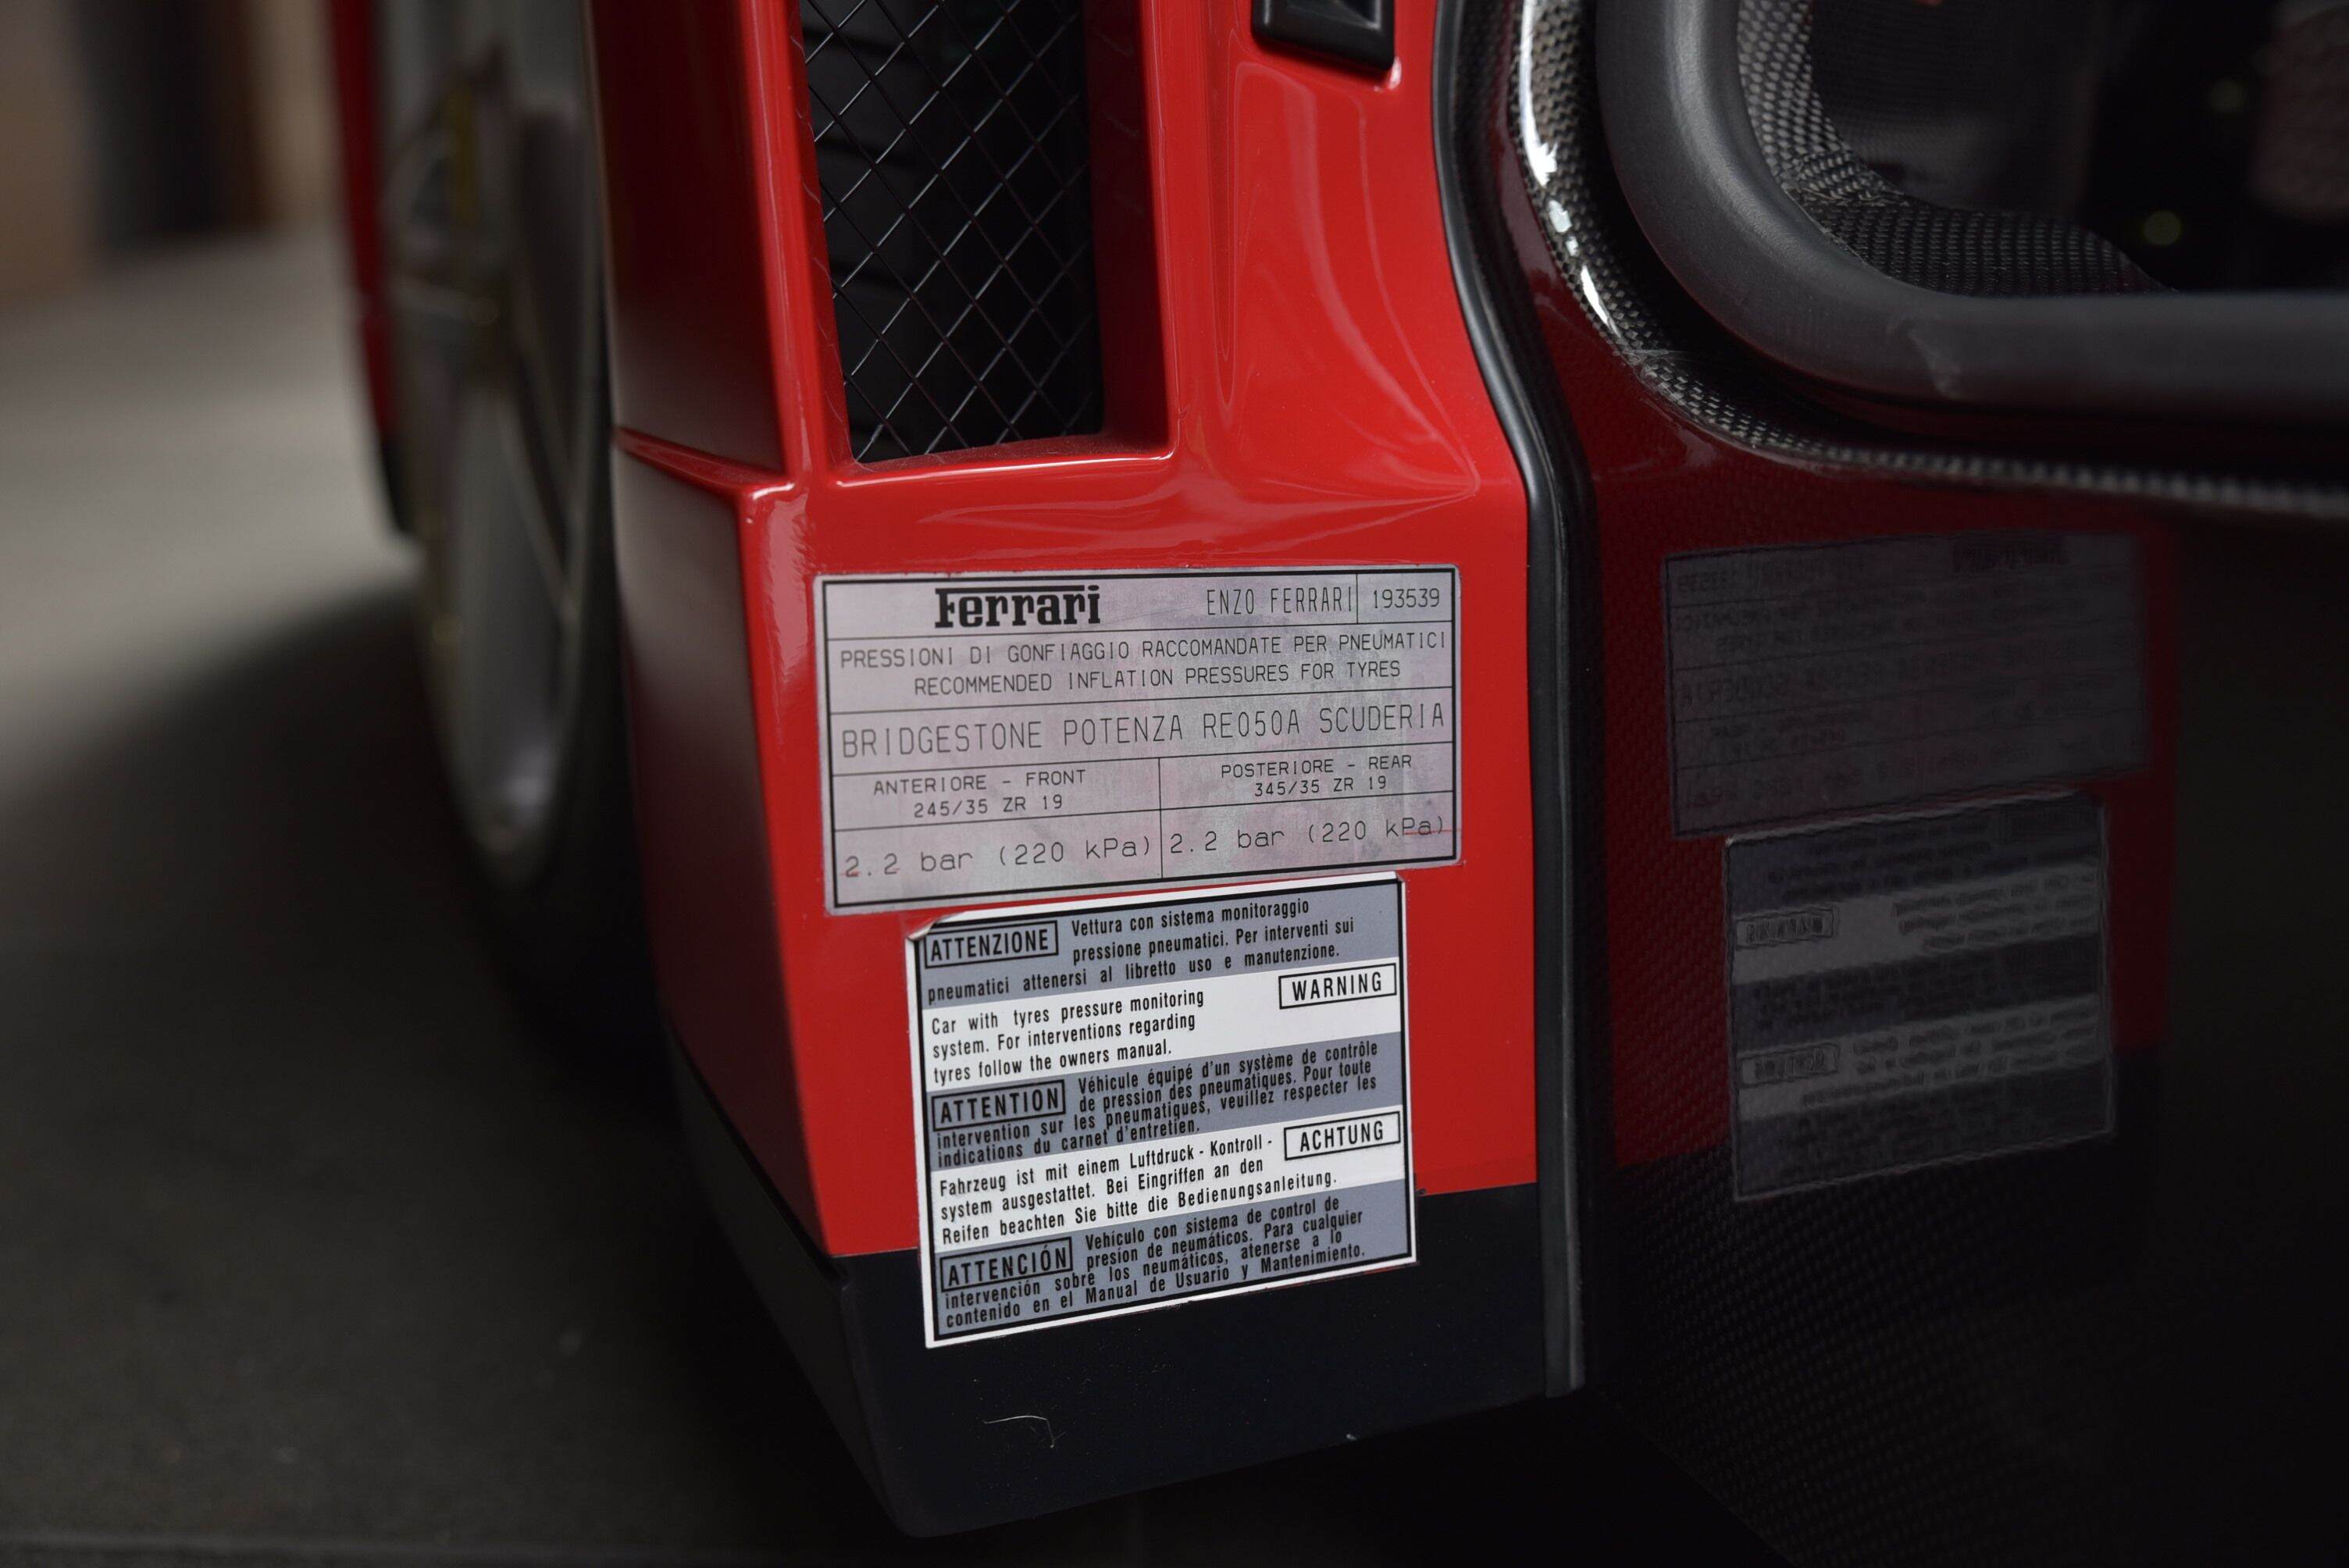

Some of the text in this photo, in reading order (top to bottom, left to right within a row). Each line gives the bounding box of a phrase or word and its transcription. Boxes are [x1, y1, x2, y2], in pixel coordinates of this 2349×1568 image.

[935, 585, 1100, 628] Ferrari
[1207, 586, 1352, 615] ENZO FERRARI
[1374, 588, 1440, 608] 193539
[840, 632, 1445, 668] PRESSIONI DI GONFIAGGIO RACCOMANDATE PER PNEUMATICI
[915, 661, 1400, 696] RECOMMENDED INFLATION PRESSURES FOR TYRES
[843, 721, 1042, 758] BRIDGESTONE
[1064, 715, 1182, 747] POTENZA
[1320, 704, 1443, 733] SCUDERIA
[874, 775, 986, 795] ANTERIORE
[1026, 769, 1085, 786] FRONT
[1221, 759, 1334, 779] POSTERIORE
[1368, 755, 1412, 769] REAR
[1255, 776, 1386, 797] 345/35 ZR 19
[914, 795, 1062, 818] 245/35 ZR 19
[844, 836, 1149, 877] 2.2 bar (220 kPa)
[1170, 816, 1443, 853] 2.2 bar (220 kPa)
[1071, 897, 1309, 936] Vettura con sistema monitoraggio
[931, 928, 1049, 962] ATTENZIONE
[1073, 918, 1354, 966] pressione pneumatici. Per interventi sui
[929, 943, 1339, 1006] pneumatici attenersi al libretto uso e manutenzione.
[1292, 971, 1381, 1001] WARNING
[932, 989, 1203, 1035] Car with tyres pressure monitoring
[933, 1014, 1195, 1060] system. For interventions regarding
[934, 1039, 1171, 1086] tyres follow the owners manual.
[1078, 1040, 1378, 1092] Véhicule équipé d'un système de contrôle
[940, 1088, 1058, 1124] ATTENTION
[1080, 1060, 1371, 1115] de pression des pneumatiques. Pour toute
[937, 1076, 1376, 1149] intervention sur les pneumatiques, veuillez respecter les
[938, 1119, 1199, 1168] indications du carnet d'entretien.
[1300, 1121, 1383, 1152] ACHTUNG
[940, 1174, 1006, 1196] Fahrzeug
[1017, 1170, 1034, 1185] ist
[1046, 1164, 1068, 1181] mit
[1078, 1157, 1119, 1177] einem
[1130, 1145, 1194, 1169] Luftdruck
[1210, 1134, 1262, 1156] Kontroll
[941, 1159, 1263, 1222] system ausgestattet. Bei Eingriffen an den
[943, 1171, 1336, 1245] Reifen beachten Sie bitte die Bedienungsanleitung.
[1086, 1196, 1338, 1250] Vehículo con sistema de control de
[1147, 1243, 1163, 1258] de
[1172, 1232, 1253, 1254] neumáticos.
[1264, 1222, 1293, 1238] Para
[1303, 1210, 1363, 1232] cualquier
[945, 1229, 1342, 1310] intervención sobre los neumáticos, atenerse a lo
[946, 1244, 1364, 1328] contenido en el Manual de Usuario y Mantenimiento.
[948, 1244, 1067, 1287] ATTENCIÓN
